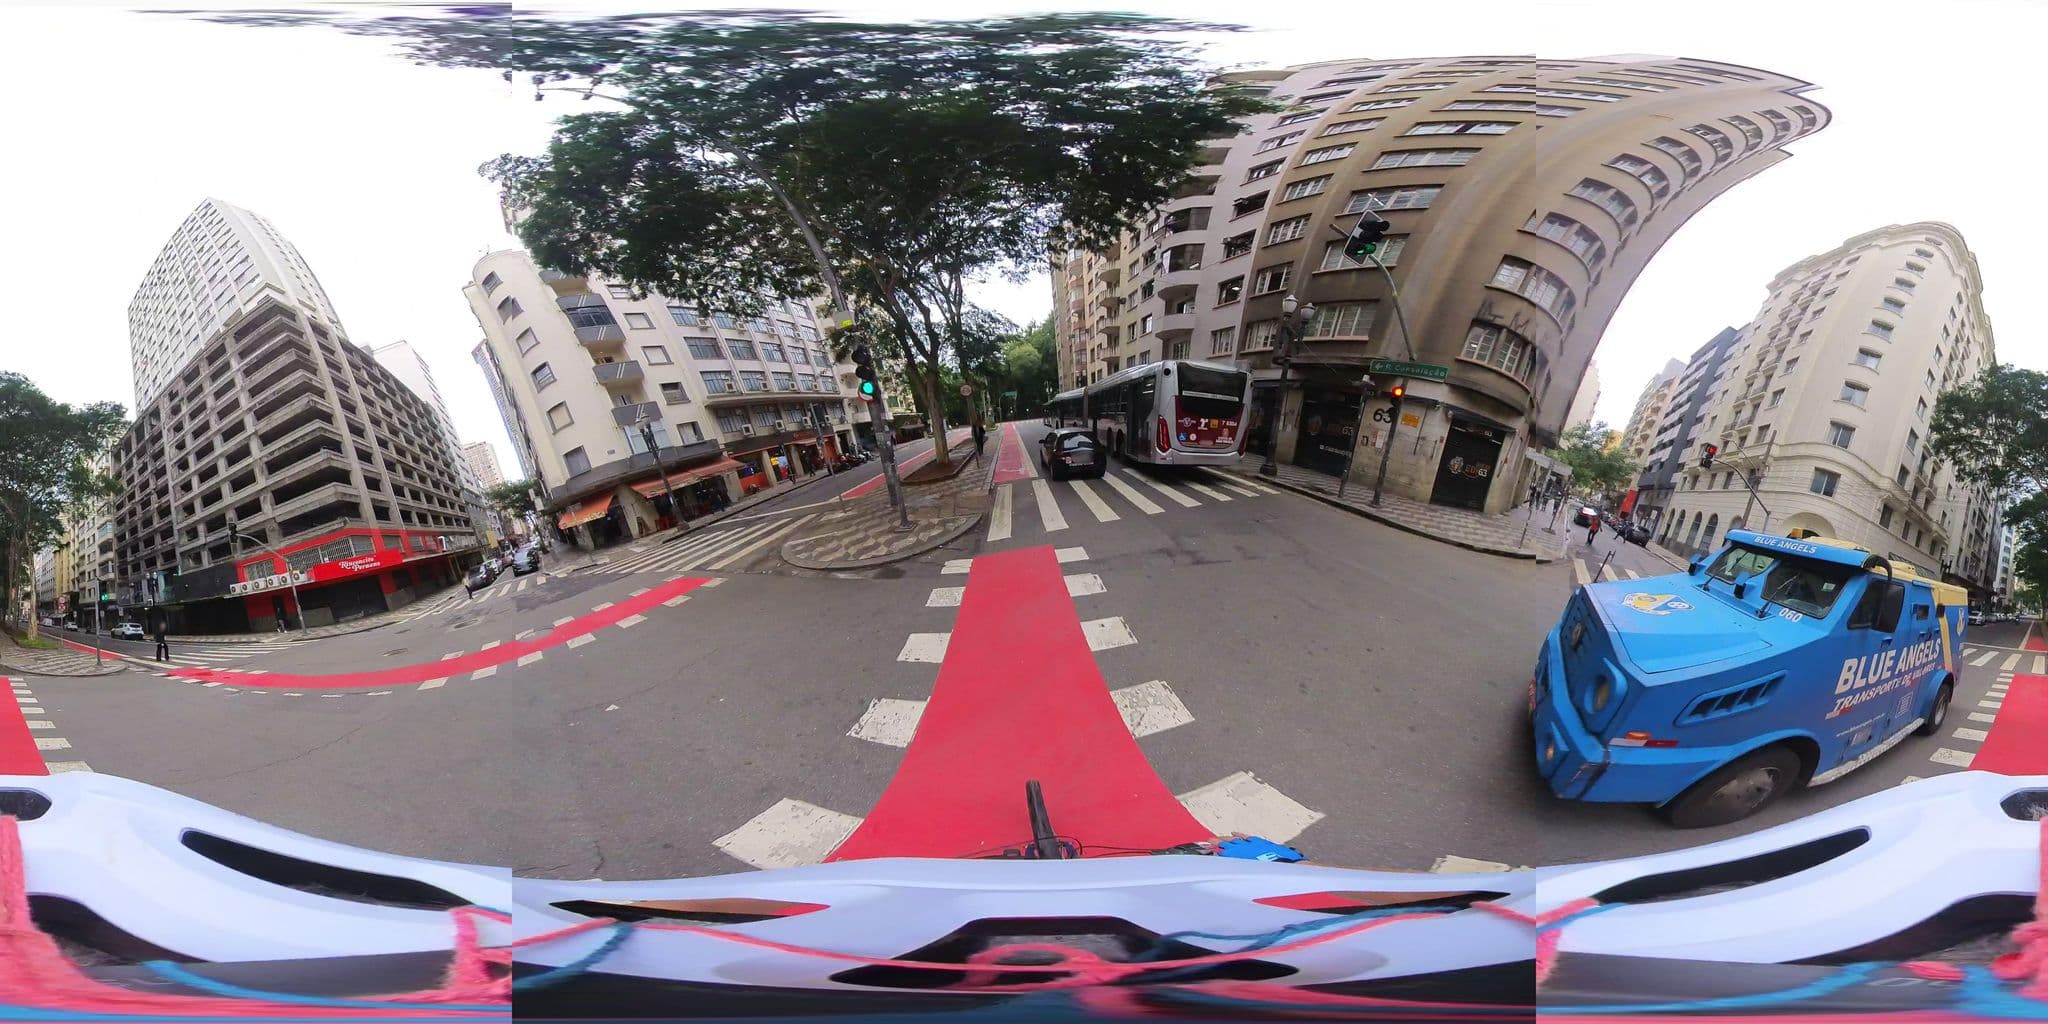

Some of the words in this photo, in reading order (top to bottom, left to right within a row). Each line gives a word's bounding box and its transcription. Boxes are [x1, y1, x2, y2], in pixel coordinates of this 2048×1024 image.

[1395, 365, 1446, 377] Consolação
[1754, 536, 1777, 546] BLUE
[1777, 541, 1817, 554] ANGELS
[1779, 607, 1802, 622] 060
[1835, 649, 1897, 694] BLUE
[1894, 638, 1940, 674] ANGELS
[1833, 677, 1902, 713] TRANSPORTE
